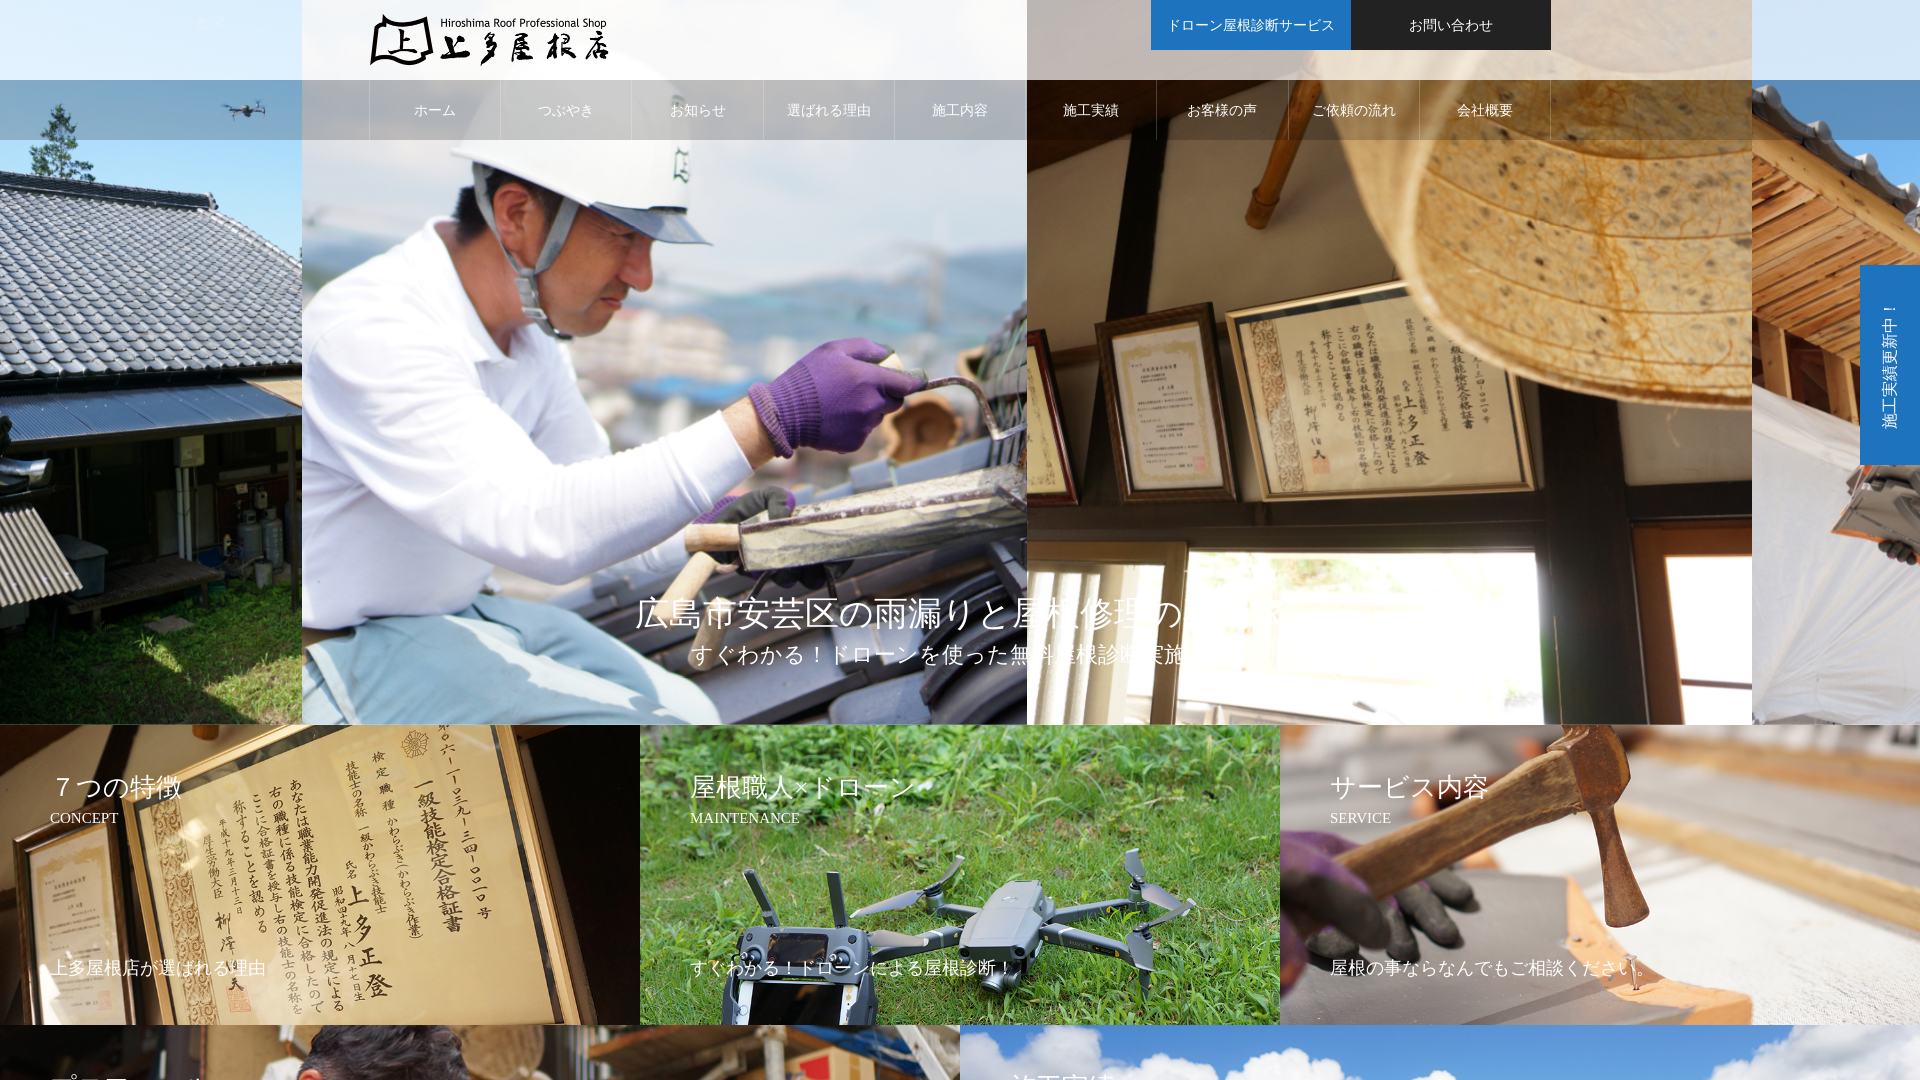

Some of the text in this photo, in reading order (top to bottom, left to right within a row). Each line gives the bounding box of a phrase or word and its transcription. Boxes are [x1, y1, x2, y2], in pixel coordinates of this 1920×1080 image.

[232, 800, 267, 933] 称することを認める
[252, 794, 302, 1015] ここに合格証書を授与し右の技能士の名称を
[269, 786, 325, 1013] 右の職種に係る技能検定に合格したので
[290, 780, 344, 1012] あなたは職業能力開発促進法の規定による
[345, 860, 393, 998] 氏名 上多正登
[414, 780, 463, 932] 一級技能検定合格証書
